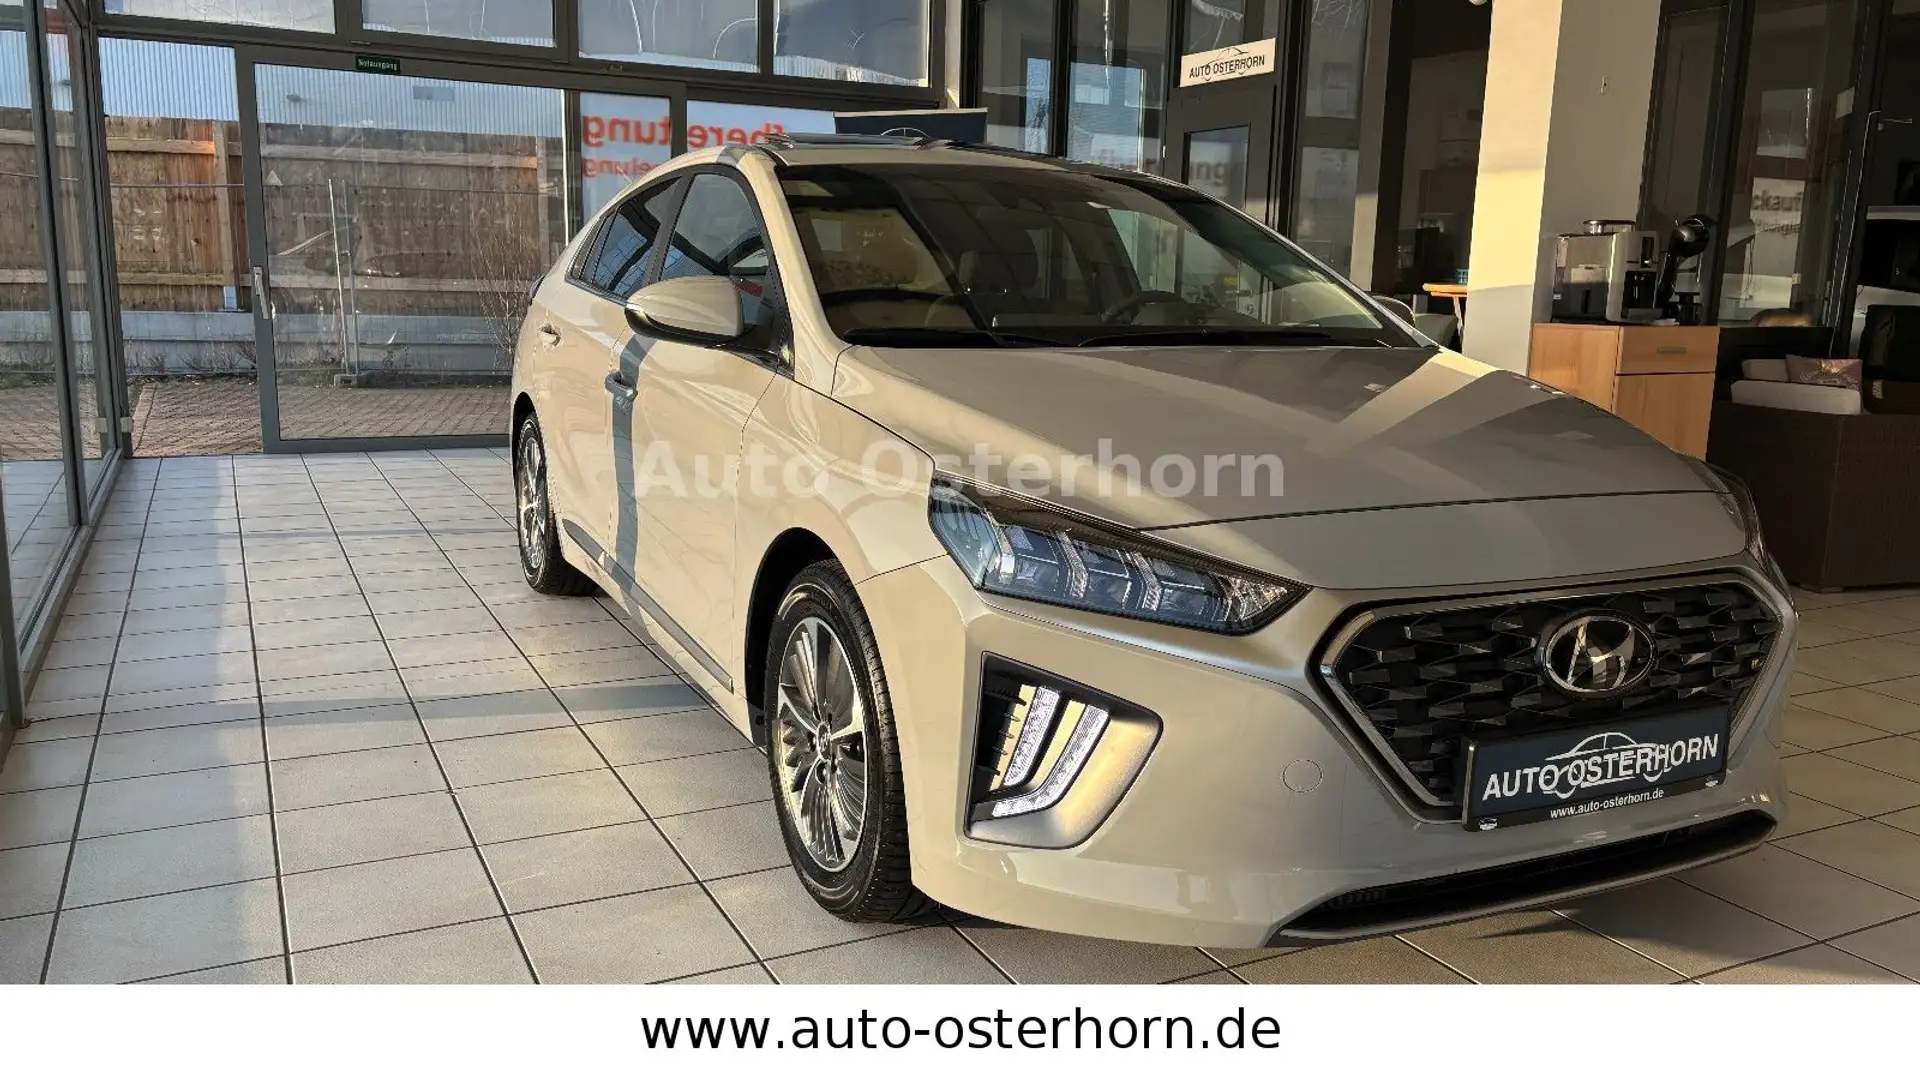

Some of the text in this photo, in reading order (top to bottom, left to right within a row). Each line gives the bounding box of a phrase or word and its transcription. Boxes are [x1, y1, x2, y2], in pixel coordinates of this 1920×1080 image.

[358, 57, 398, 71] Notausgang
[1189, 54, 1265, 78] AUTO OSTERHORN
[1482, 734, 1719, 801] AUTO OSTERHORN
[1550, 787, 1664, 819] www.auto-osterhorn.de
